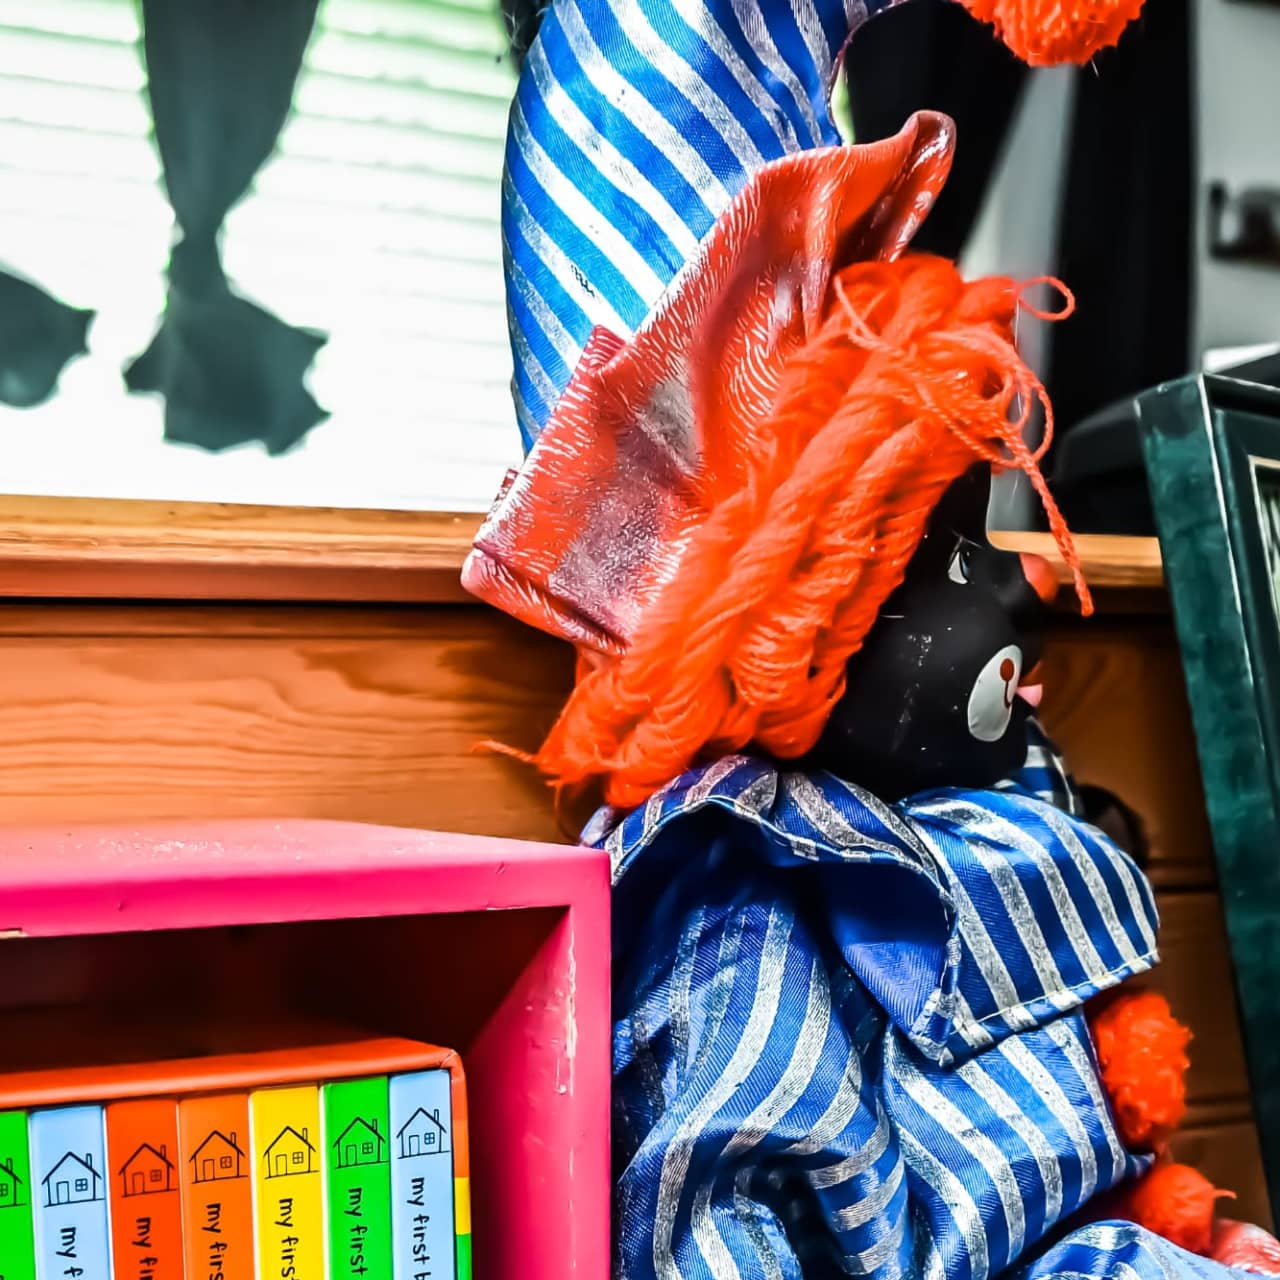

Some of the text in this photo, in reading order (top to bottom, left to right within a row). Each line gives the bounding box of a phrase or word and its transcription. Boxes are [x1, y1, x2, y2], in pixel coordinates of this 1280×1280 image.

[344, 1187, 363, 1217] my
[406, 1177, 425, 1206] my
[202, 1203, 222, 1234] my
[274, 1197, 294, 1228] my
[55, 1226, 77, 1258] my
[133, 1217, 151, 1248] my
[412, 1214, 430, 1265] first
[350, 1225, 368, 1276] first
